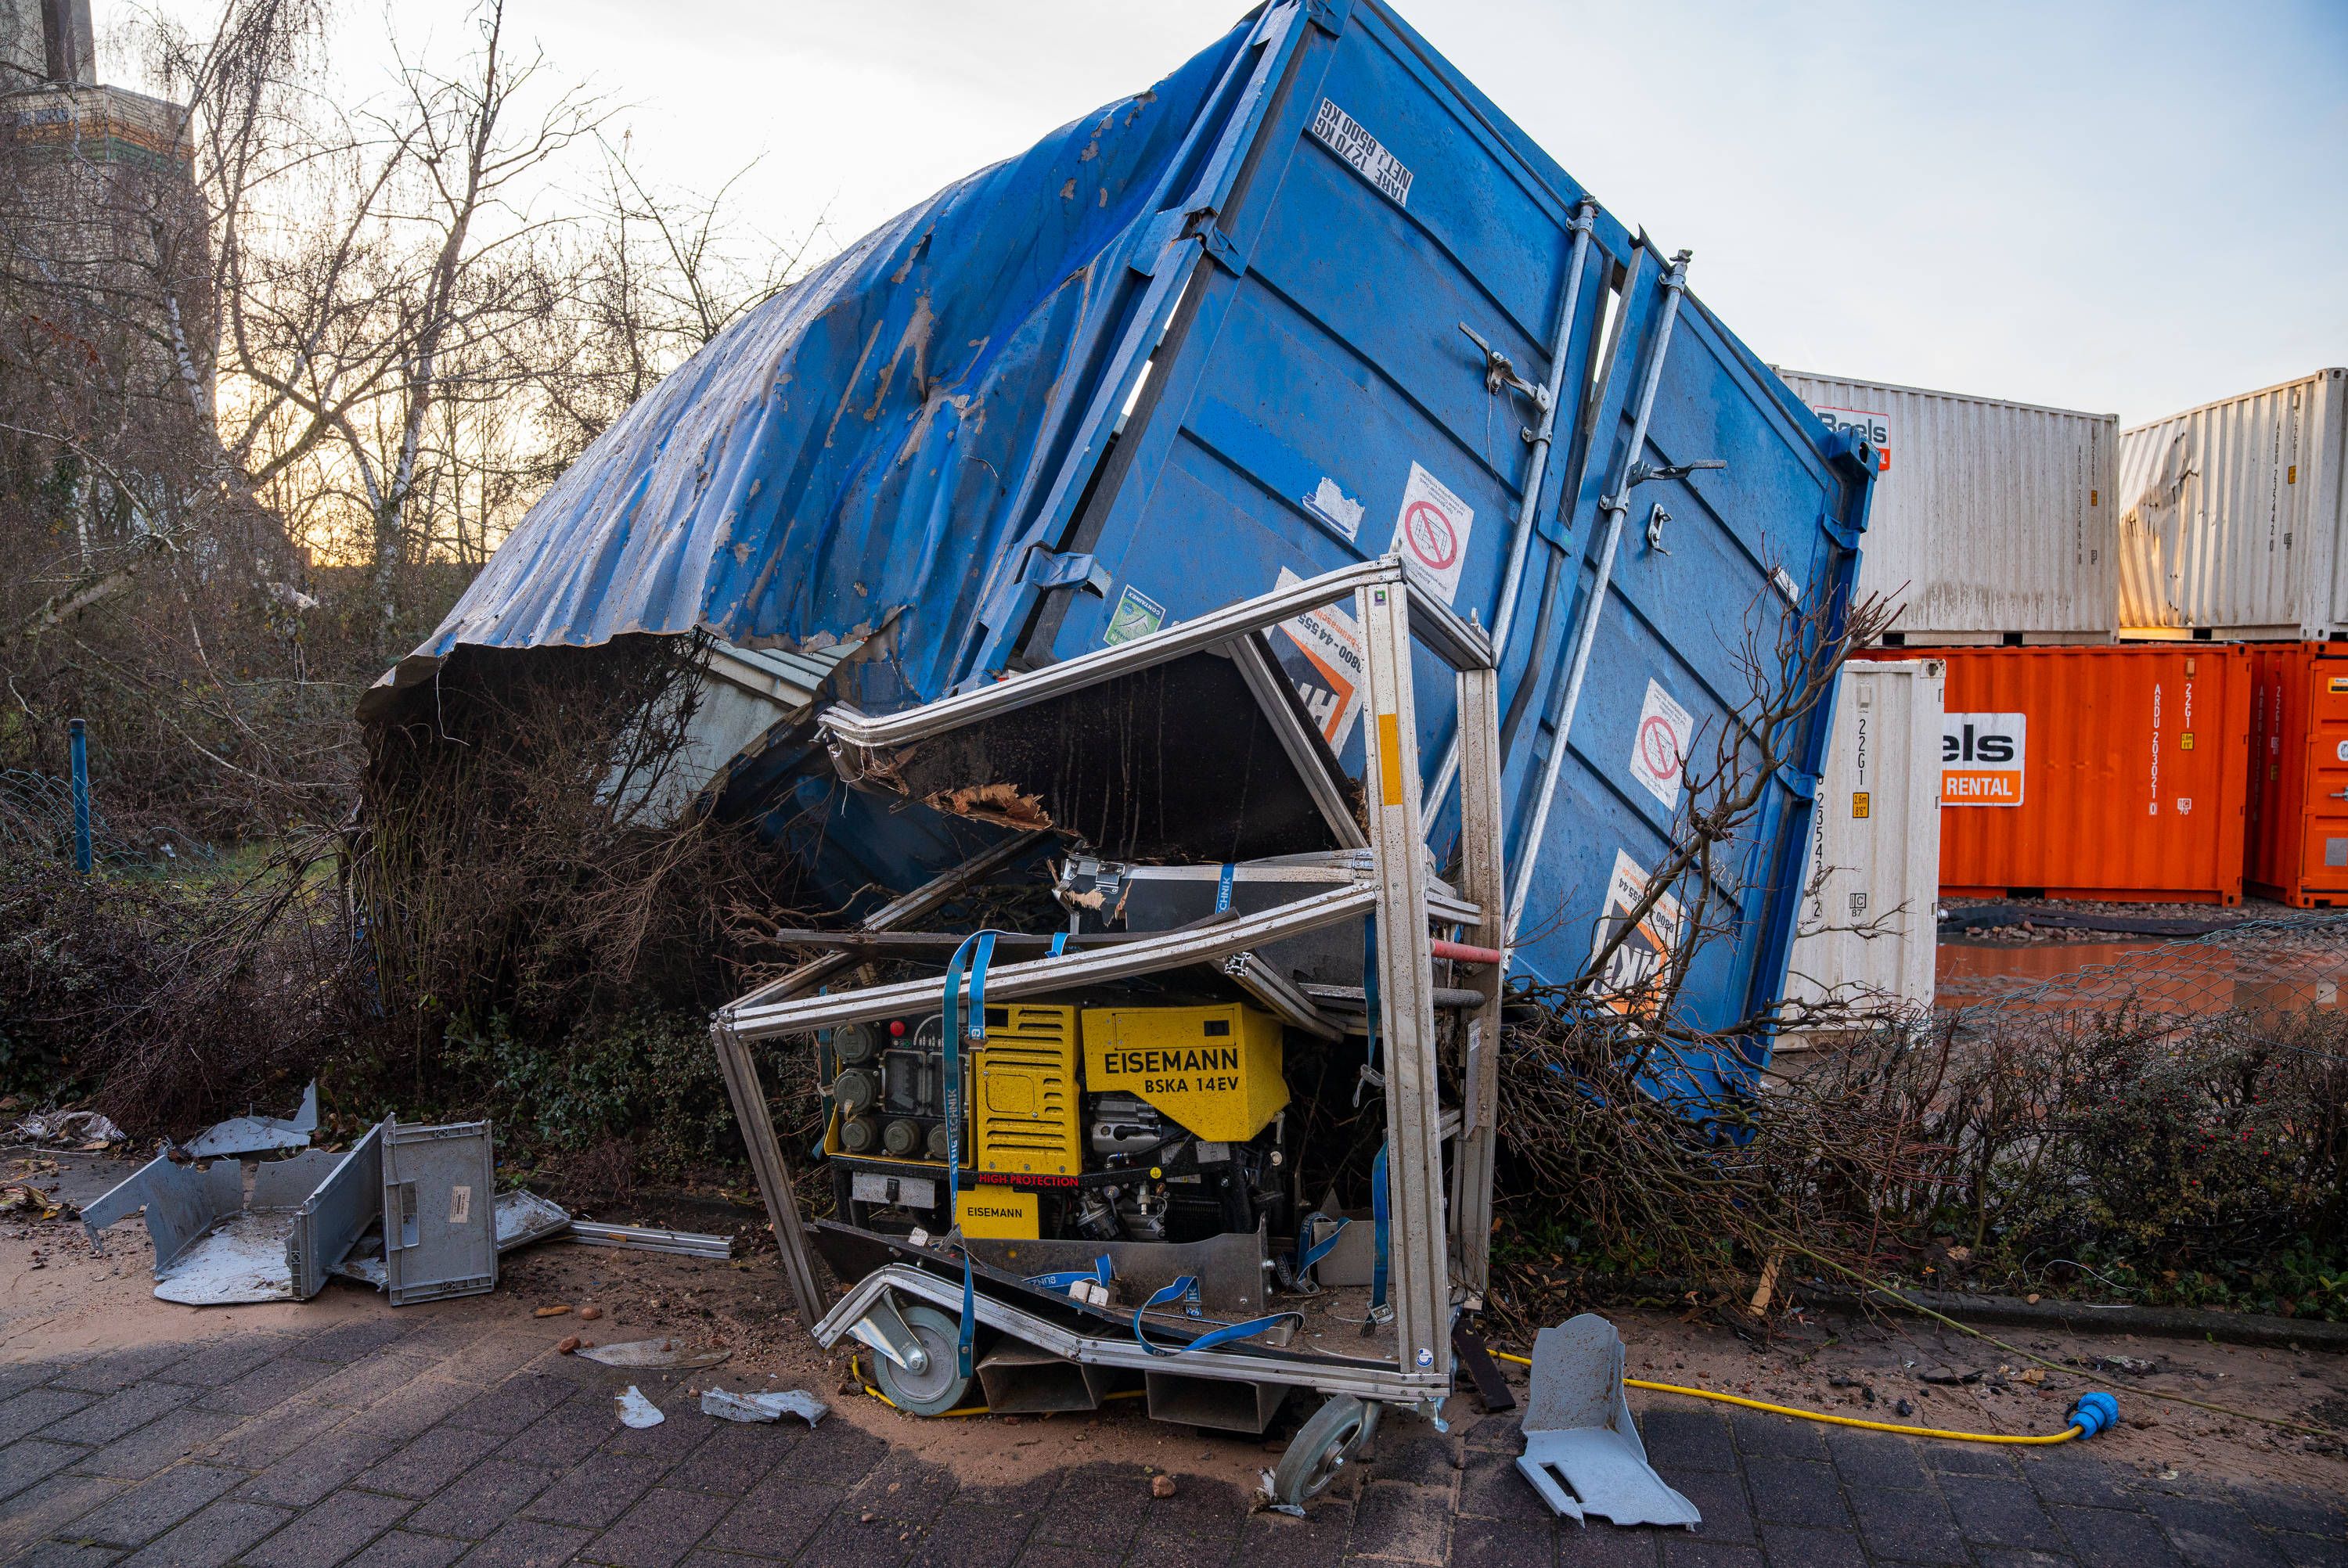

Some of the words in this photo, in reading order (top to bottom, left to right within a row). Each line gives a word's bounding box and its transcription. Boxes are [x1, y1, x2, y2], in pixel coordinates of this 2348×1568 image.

[1321, 99, 1342, 126] KG
[1314, 117, 1335, 143] KG
[1341, 117, 1377, 156] 6500
[1335, 134, 1367, 172] 1270
[1374, 167, 1404, 205] TARE
[1128, 592, 1161, 616] CONTAINEX
[1297, 614, 1320, 635] 555
[1319, 628, 1333, 646] 44
[1946, 777, 2012, 796] RENTAL
[1854, 795, 1867, 805] 2,6m
[1219, 877, 1231, 913] CHNIK
[1619, 877, 1629, 891] 44
[1104, 1048, 1239, 1074] EISEMANN
[1145, 1078, 1189, 1093] BSKA
[1197, 1076, 1239, 1091] 14EV
[948, 1088, 958, 1175] STEIGTECHNIK
[979, 1174, 1007, 1184] HIGH
[1010, 1175, 1079, 1187] PROTECTION
[967, 1207, 1023, 1218] EISEMANN
